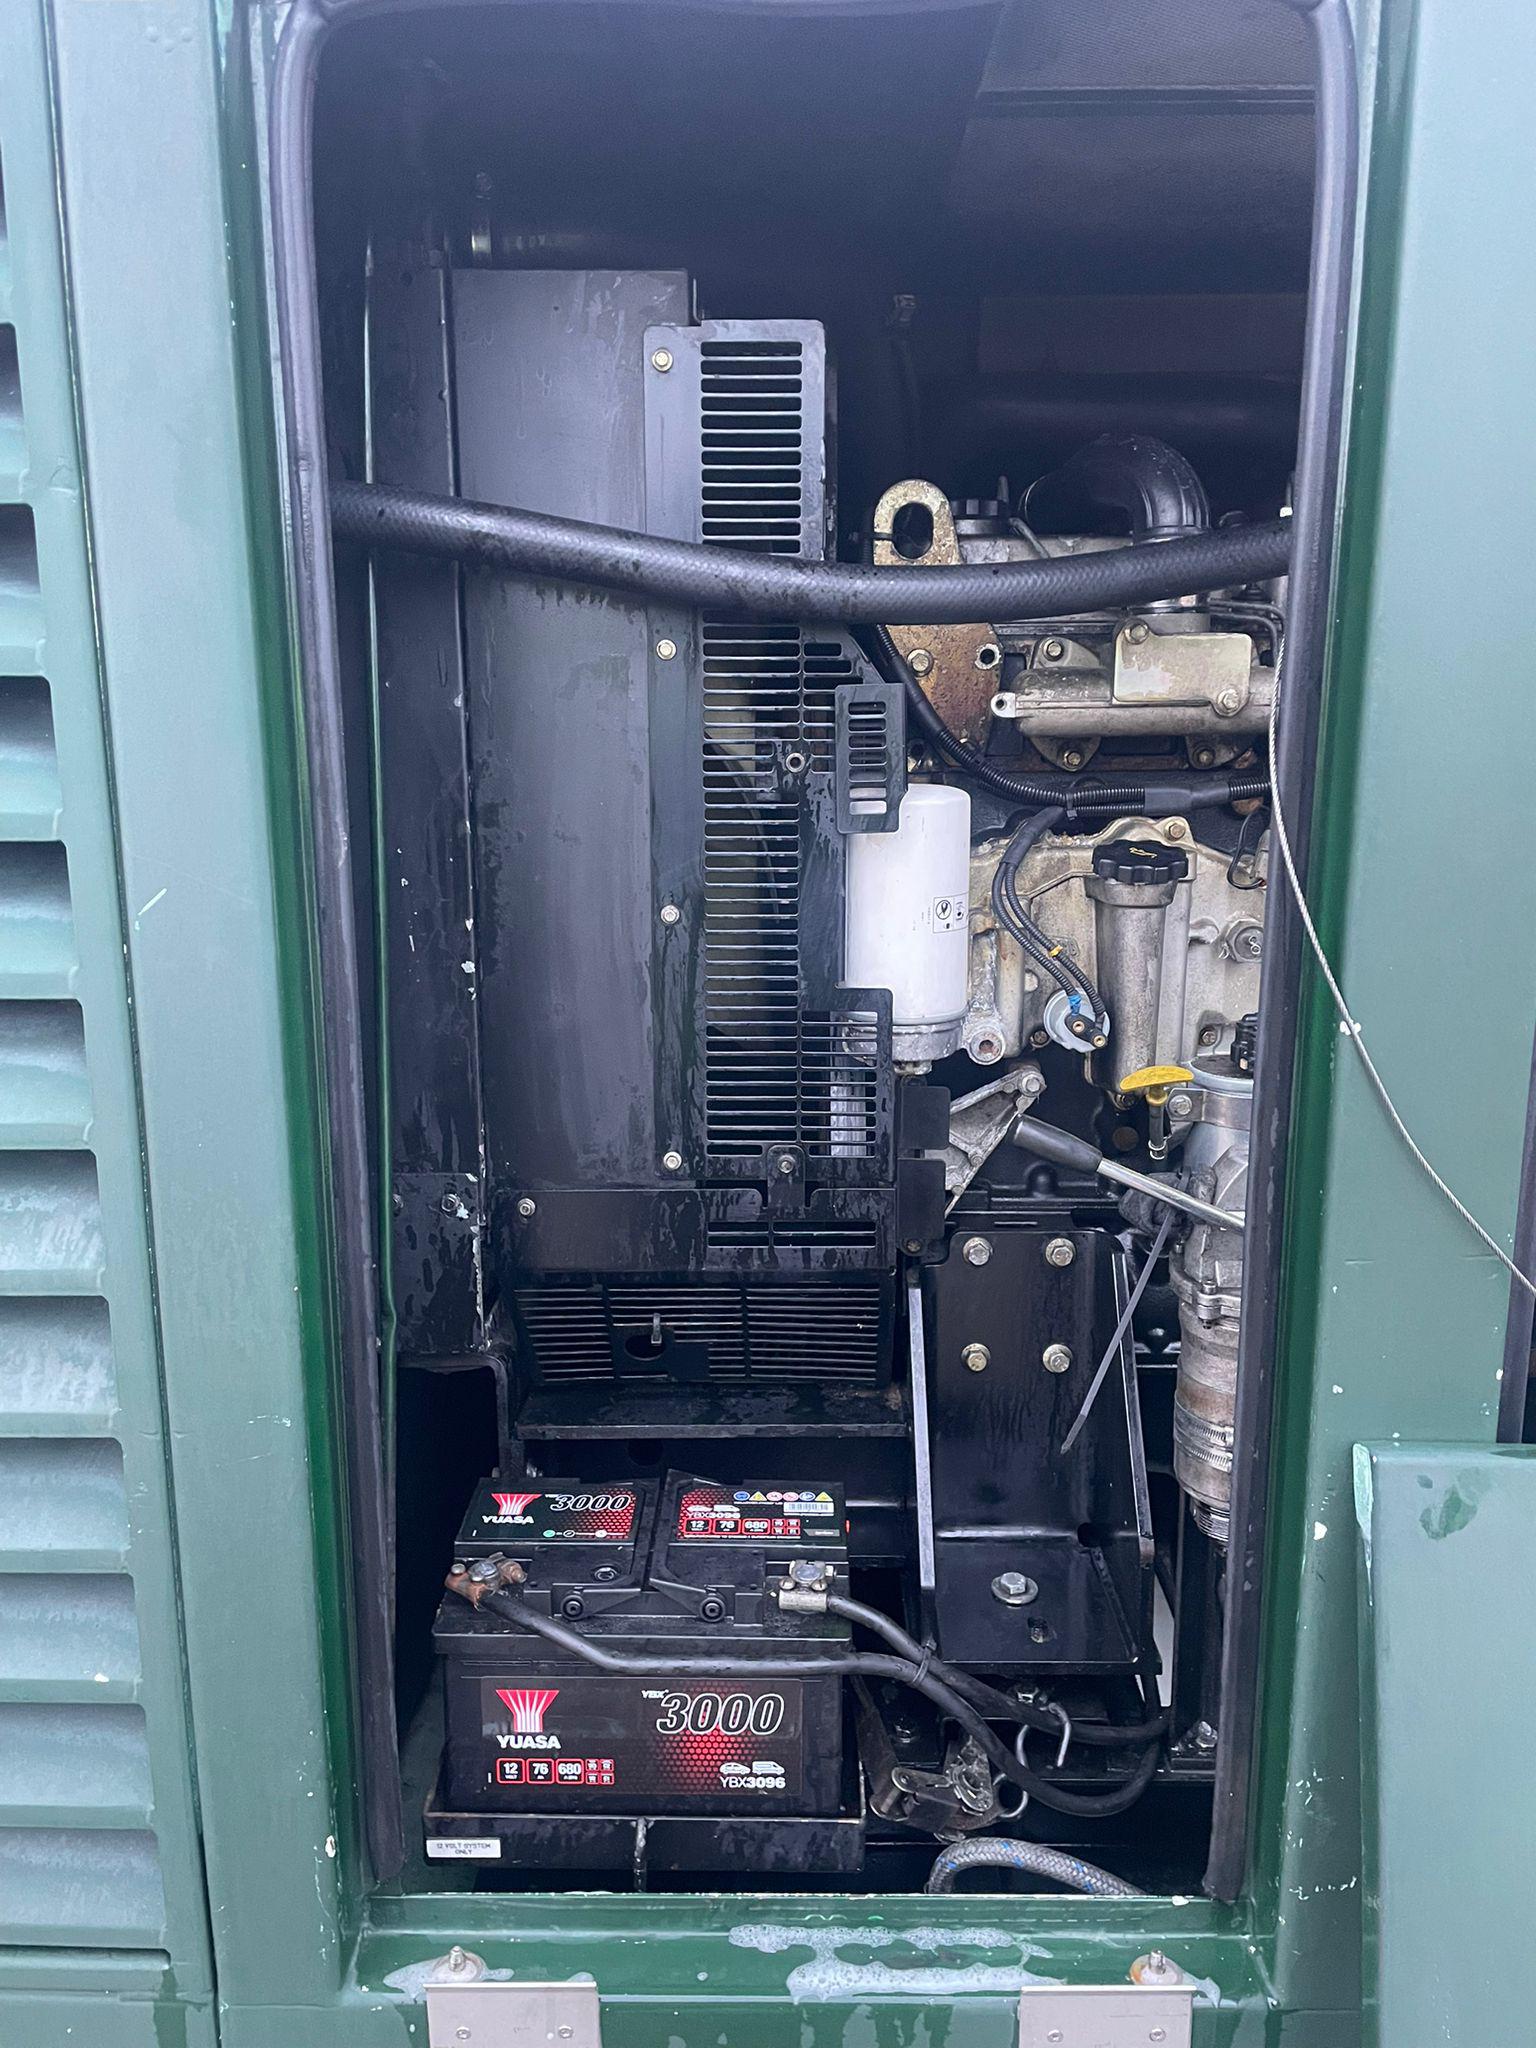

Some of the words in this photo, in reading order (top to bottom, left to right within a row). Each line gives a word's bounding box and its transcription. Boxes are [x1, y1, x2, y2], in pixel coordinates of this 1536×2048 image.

[550, 1494, 631, 1510] 3000
[482, 1515, 534, 1524] YUASA
[690, 1520, 704, 1528] 12
[744, 1521, 768, 1529] 680
[656, 1692, 785, 1735] 3000
[496, 1734, 562, 1749] YUASA
[503, 1762, 518, 1774] 12
[532, 1762, 549, 1775] 76
[558, 1762, 582, 1775] 680
[719, 1776, 786, 1788] YBX3096
